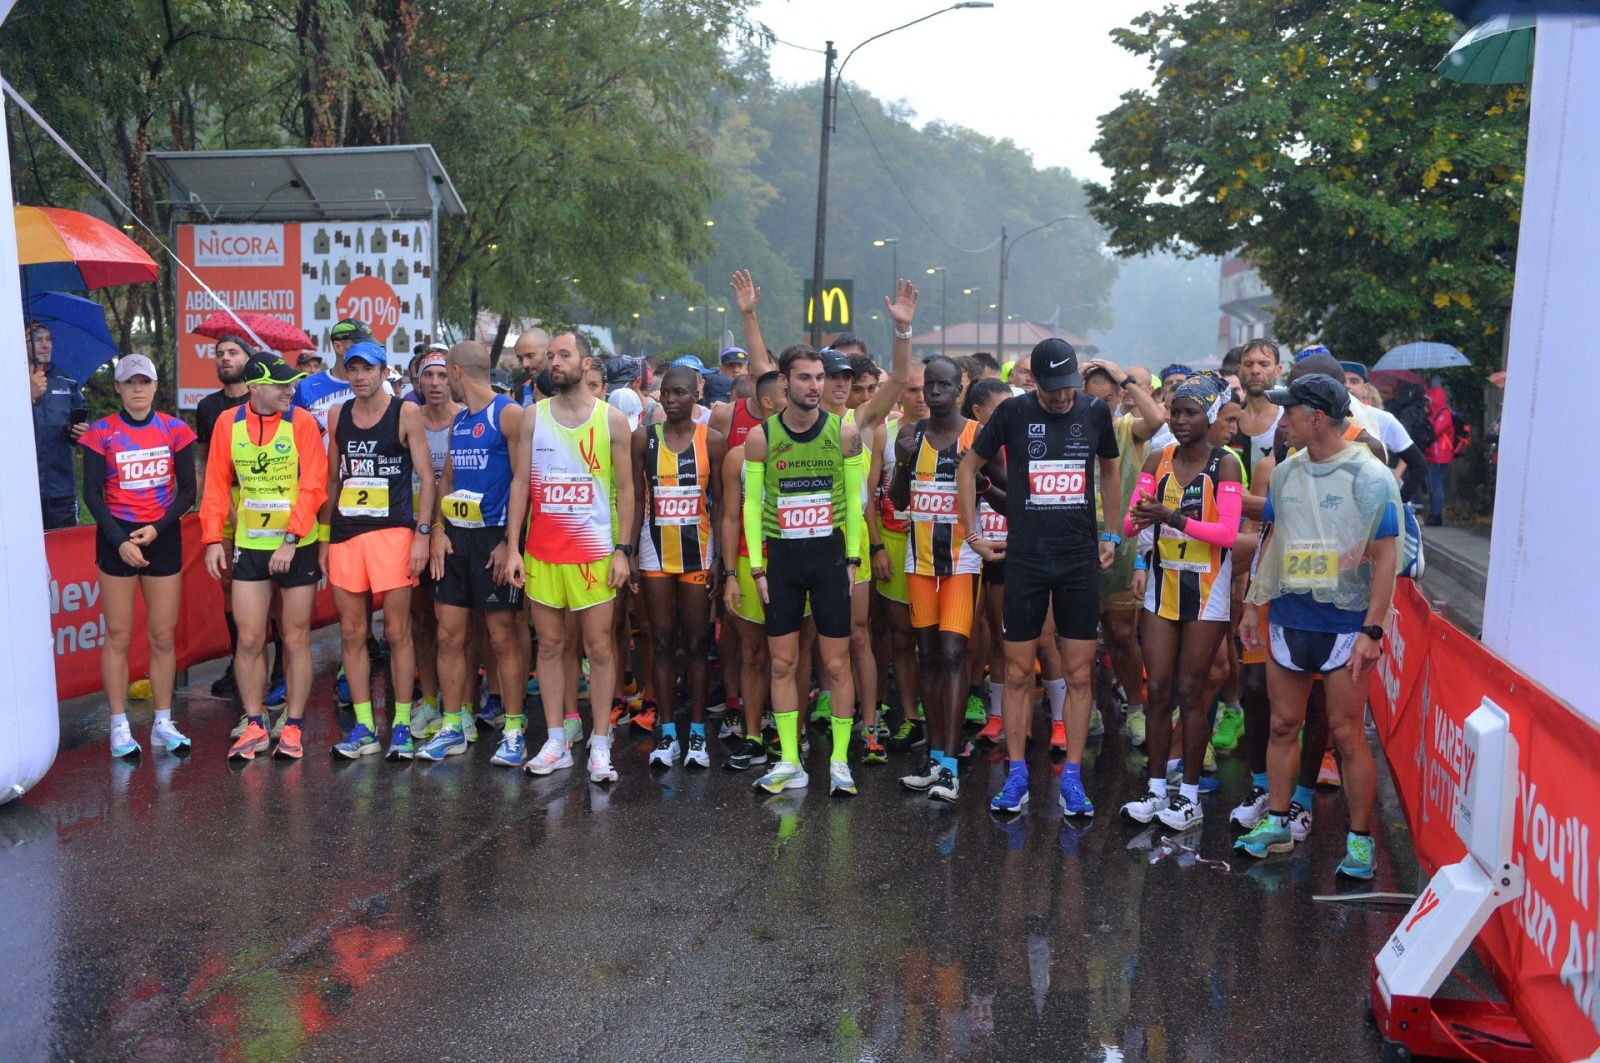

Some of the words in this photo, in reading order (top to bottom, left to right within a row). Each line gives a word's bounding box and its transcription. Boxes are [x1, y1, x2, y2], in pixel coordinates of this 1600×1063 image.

[199, 230, 279, 255] NICORA
[185, 290, 295, 310] ABBIGLIAMENTO
[347, 440, 378, 453] EA7
[122, 459, 169, 480] 1046
[788, 459, 834, 468] MERCURIO
[811, 478, 833, 487] JOLLY
[1033, 474, 1083, 492] 1090
[356, 490, 369, 505] 2
[543, 485, 590, 503] 1043
[913, 494, 955, 512] 1003
[453, 502, 469, 518] 10
[658, 499, 699, 515] 1001
[260, 513, 271, 527] 7
[782, 506, 830, 527] 1002
[1178, 541, 1187, 559] 1
[1288, 555, 1327, 575] 246
